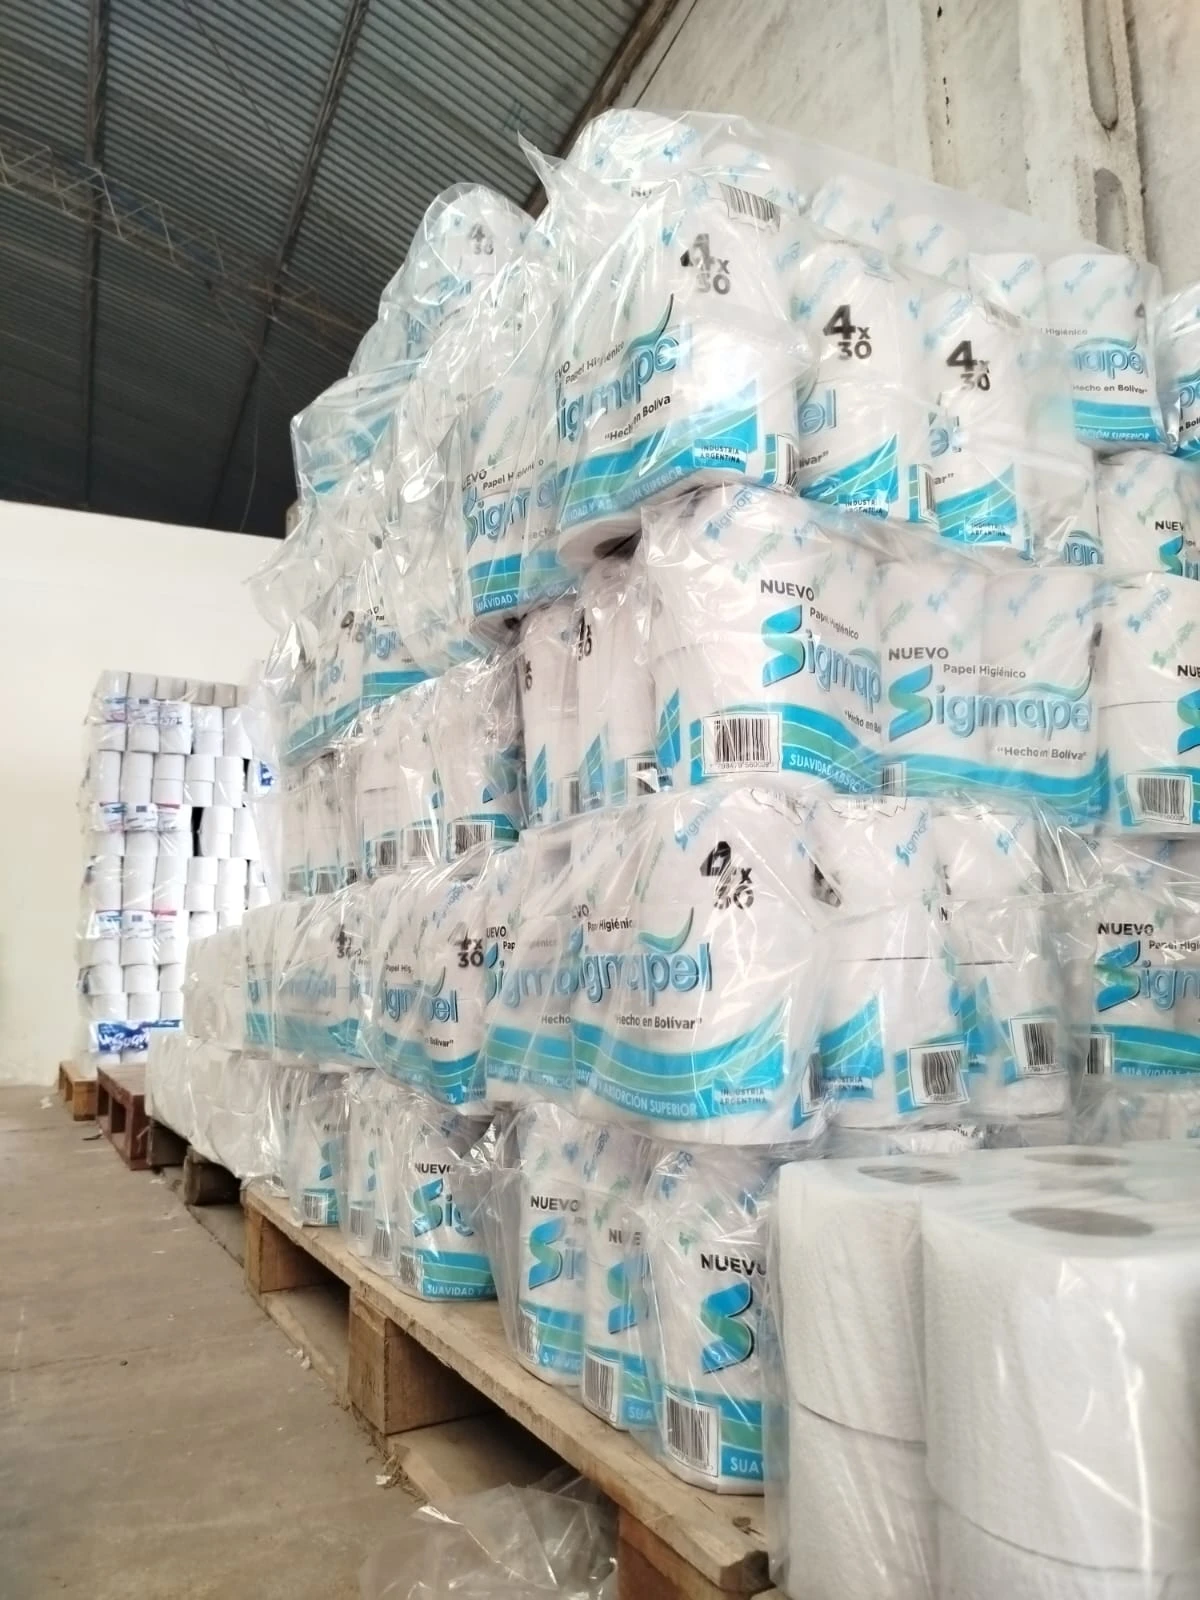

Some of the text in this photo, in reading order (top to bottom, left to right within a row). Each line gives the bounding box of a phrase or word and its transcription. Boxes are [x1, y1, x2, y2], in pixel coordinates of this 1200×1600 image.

[823, 304, 871, 340] 4x
[838, 340, 872, 360] 30
[946, 340, 990, 373] 4x
[960, 372, 991, 391] 30
[700, 453, 741, 464] ARGENTINA
[760, 579, 815, 601] NUEVO
[888, 646, 950, 661] NUEVO
[943, 663, 1027, 679] Papel Higiénico
[888, 663, 1091, 742] Sigmape
[1097, 922, 1154, 936] NUEVO
[458, 950, 485, 968] 30
[650, 1100, 698, 1117] SUPERIOR
[530, 1195, 580, 1213] NUEVO
[426, 1284, 474, 1297] SUAVIDAD
